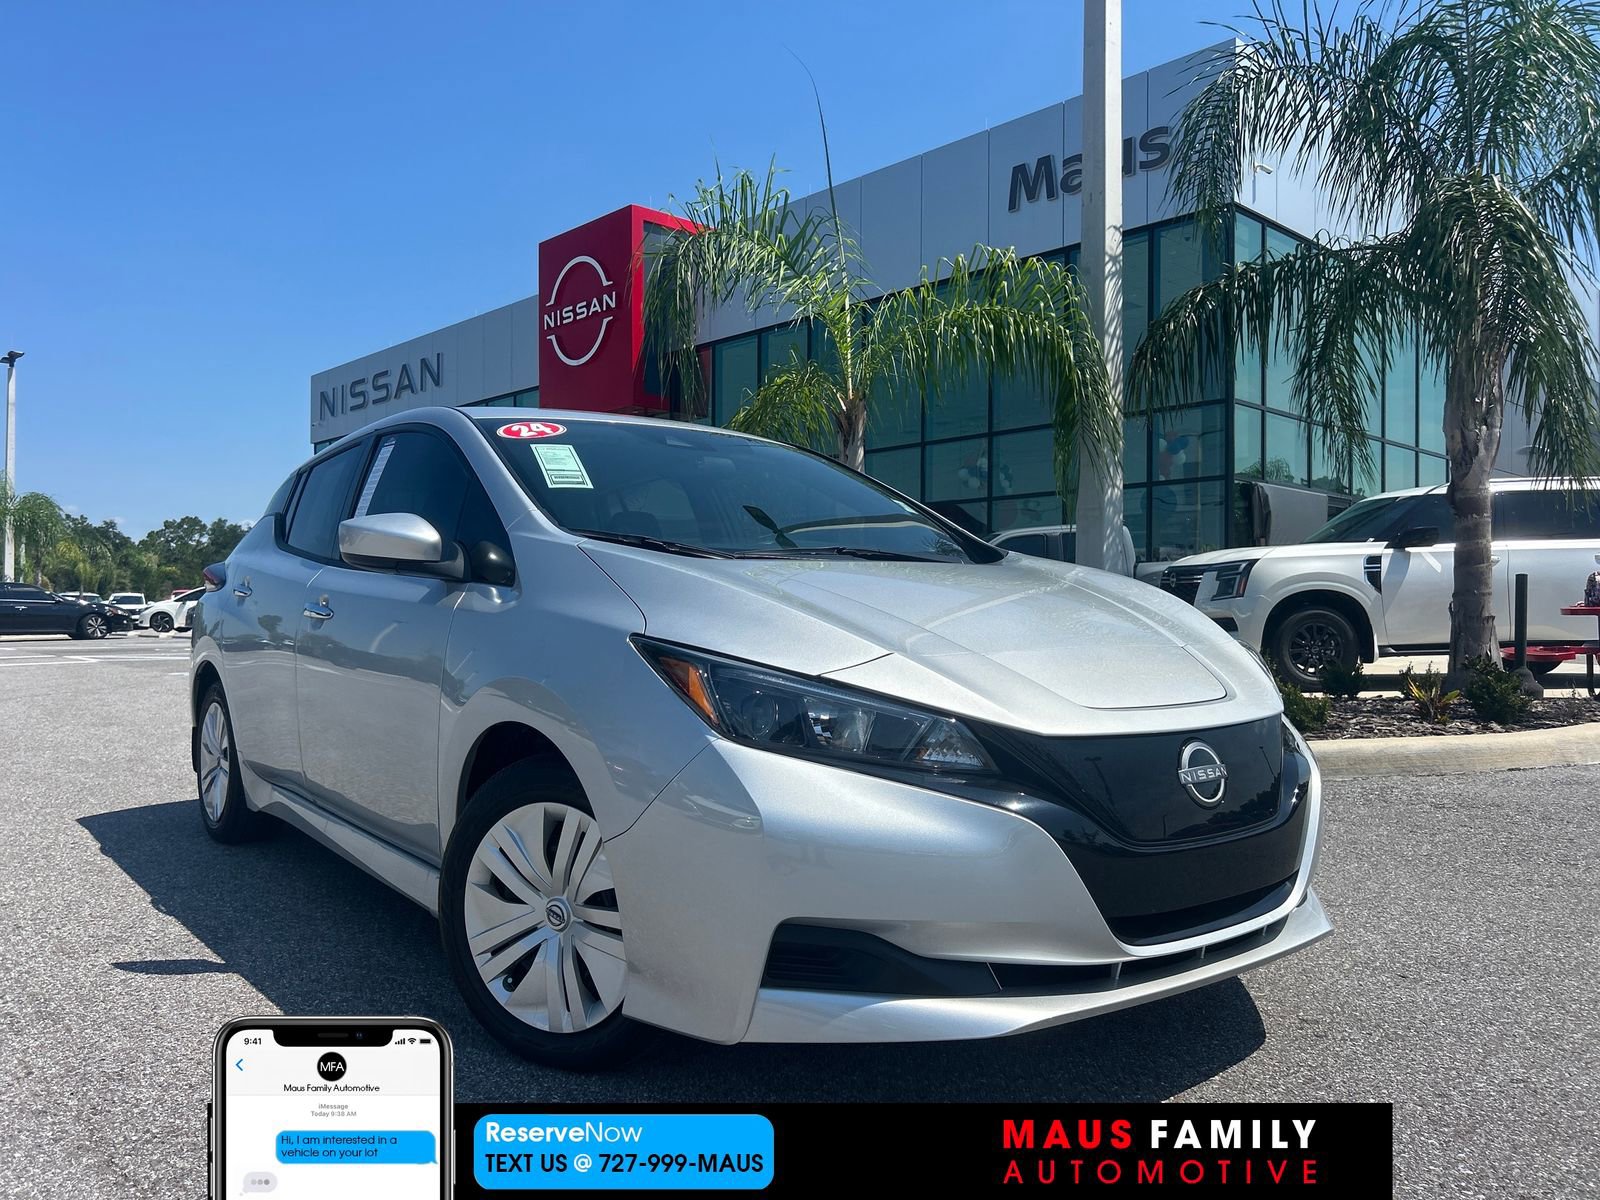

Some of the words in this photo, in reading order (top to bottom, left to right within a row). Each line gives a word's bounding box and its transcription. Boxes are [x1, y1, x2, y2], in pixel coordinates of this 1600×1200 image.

[544, 291, 616, 330] NISSAN
[319, 352, 444, 421] NISSAN
[511, 423, 554, 437] 24
[1181, 766, 1228, 783] NISSAN
